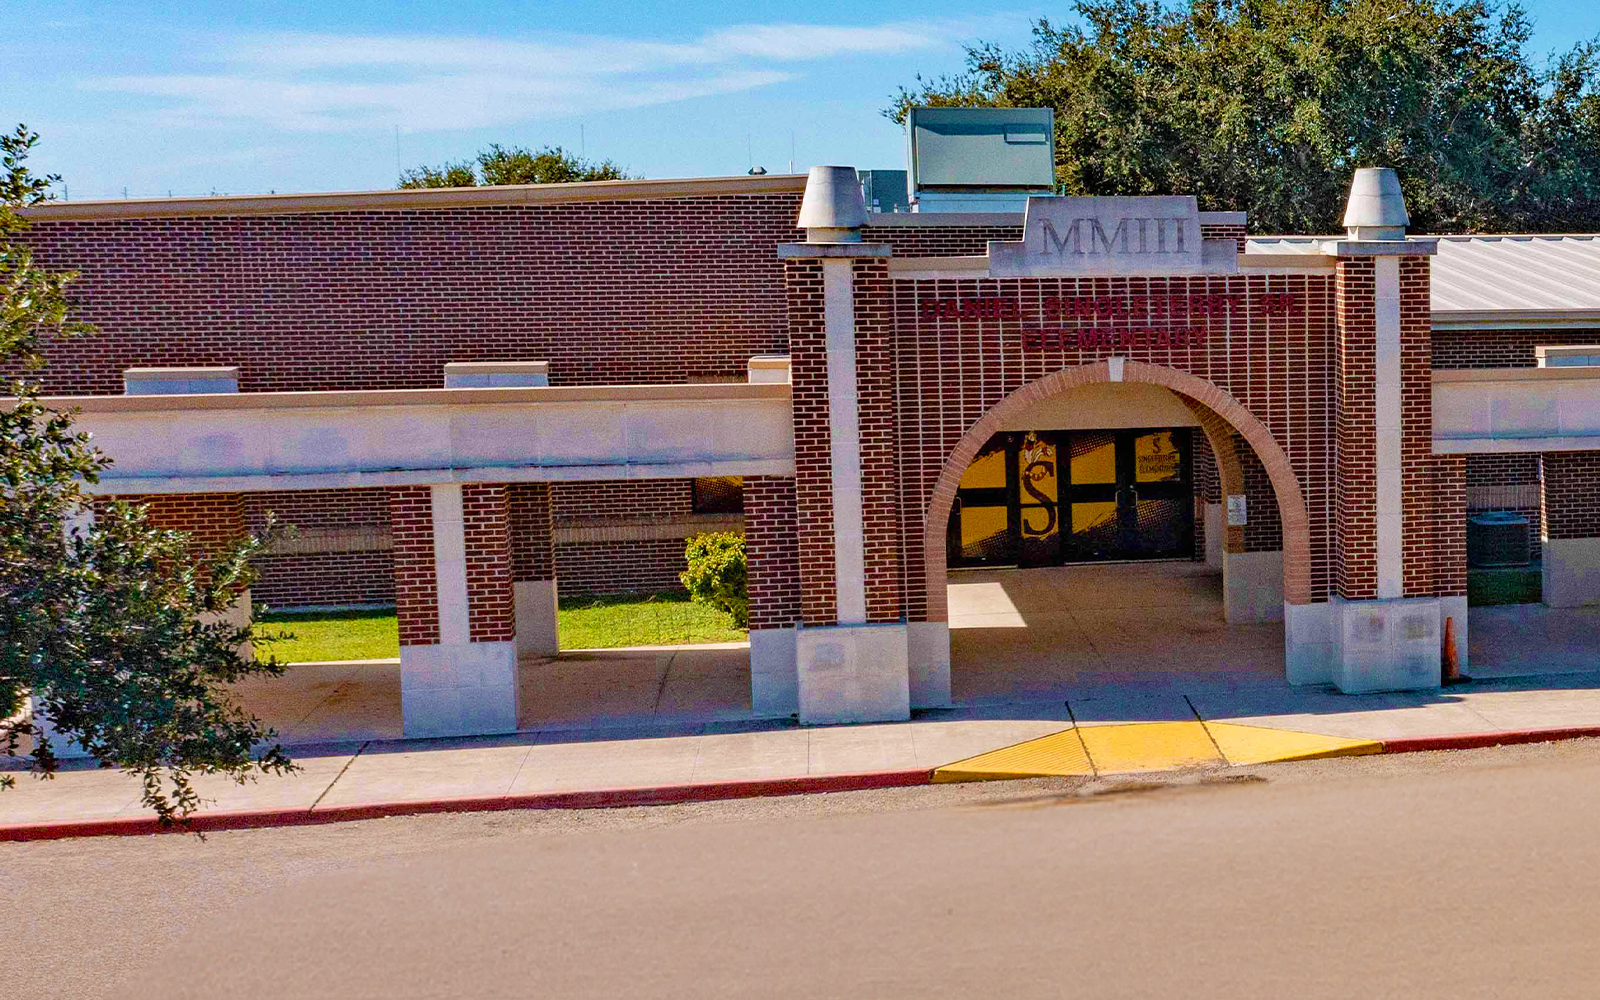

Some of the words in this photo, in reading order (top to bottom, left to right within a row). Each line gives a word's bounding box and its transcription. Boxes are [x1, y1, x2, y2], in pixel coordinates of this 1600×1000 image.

[1039, 217, 1191, 255] MMIII
[921, 297, 1025, 321] DANIEL
[1044, 294, 1241, 320] SINGLETERRY
[1021, 327, 1208, 352] ELEMENTARY
